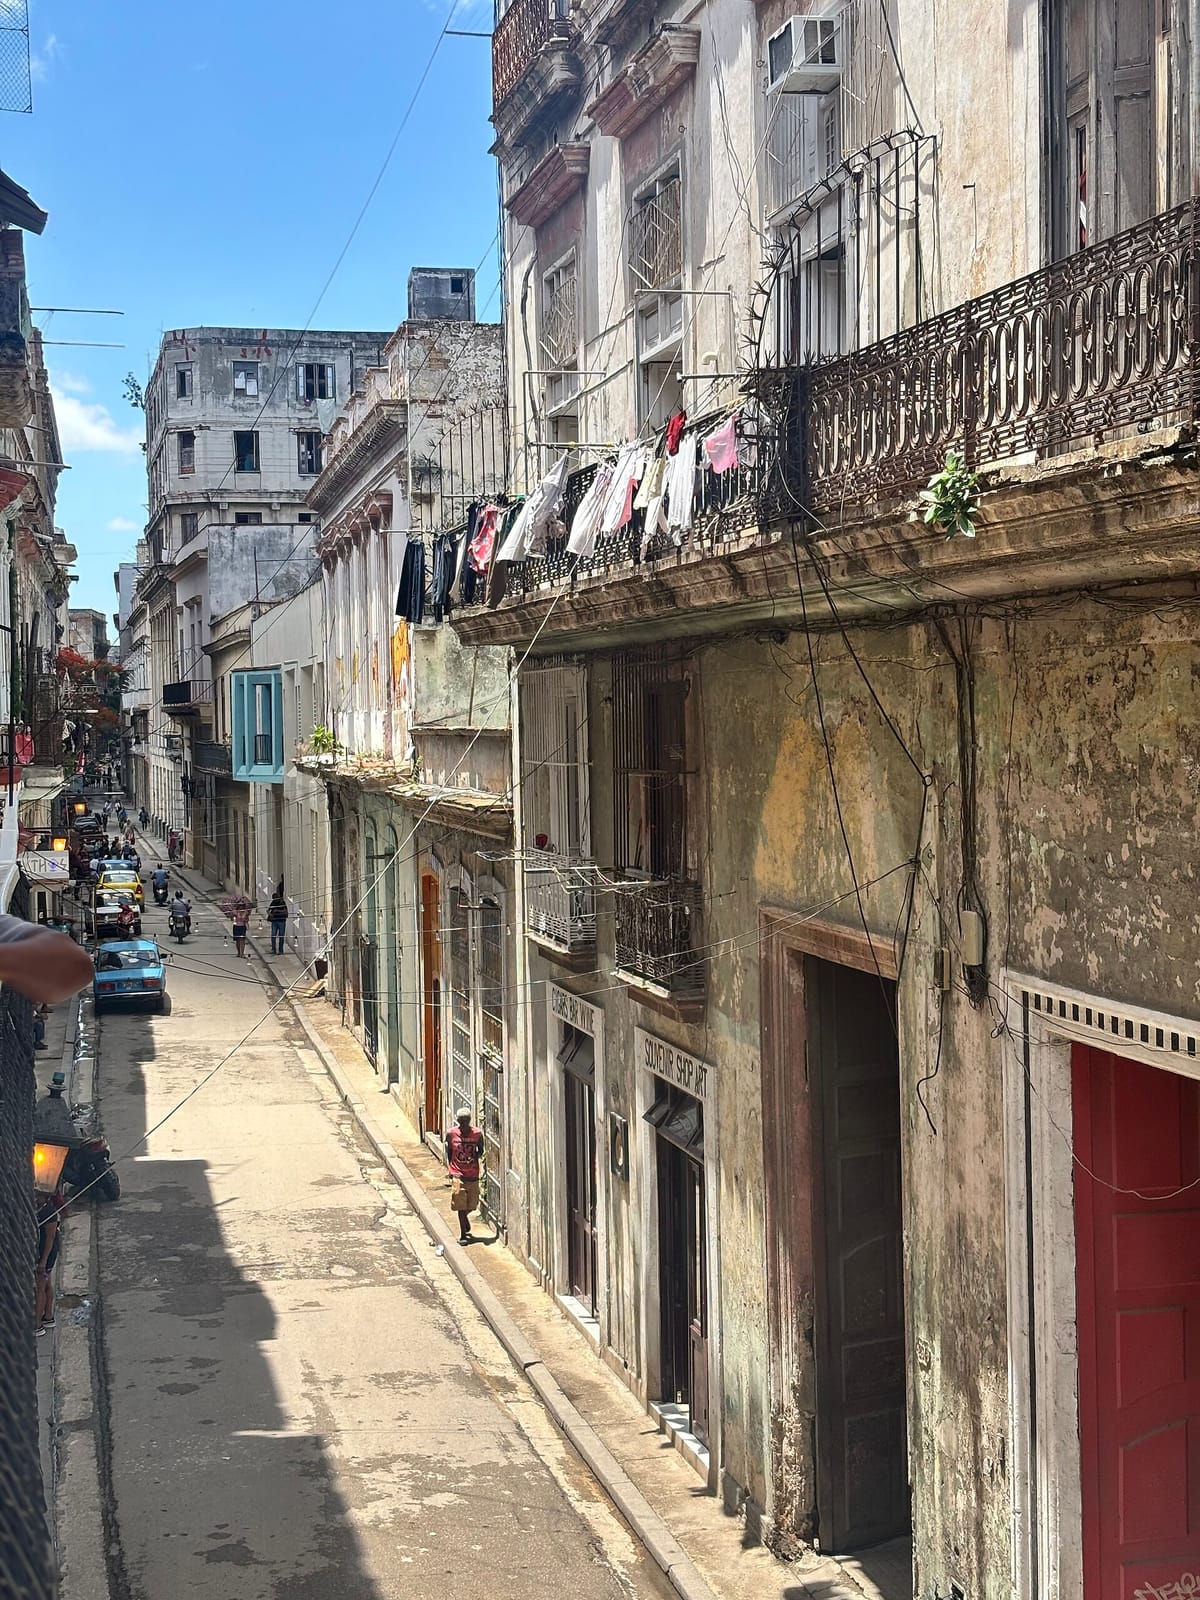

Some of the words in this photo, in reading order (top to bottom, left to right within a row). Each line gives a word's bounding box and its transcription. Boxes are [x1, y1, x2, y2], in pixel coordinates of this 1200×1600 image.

[645, 1038, 674, 1080] SOUVENIR
[676, 1053, 693, 1089] SHOP
[694, 1063, 708, 1098] ART
